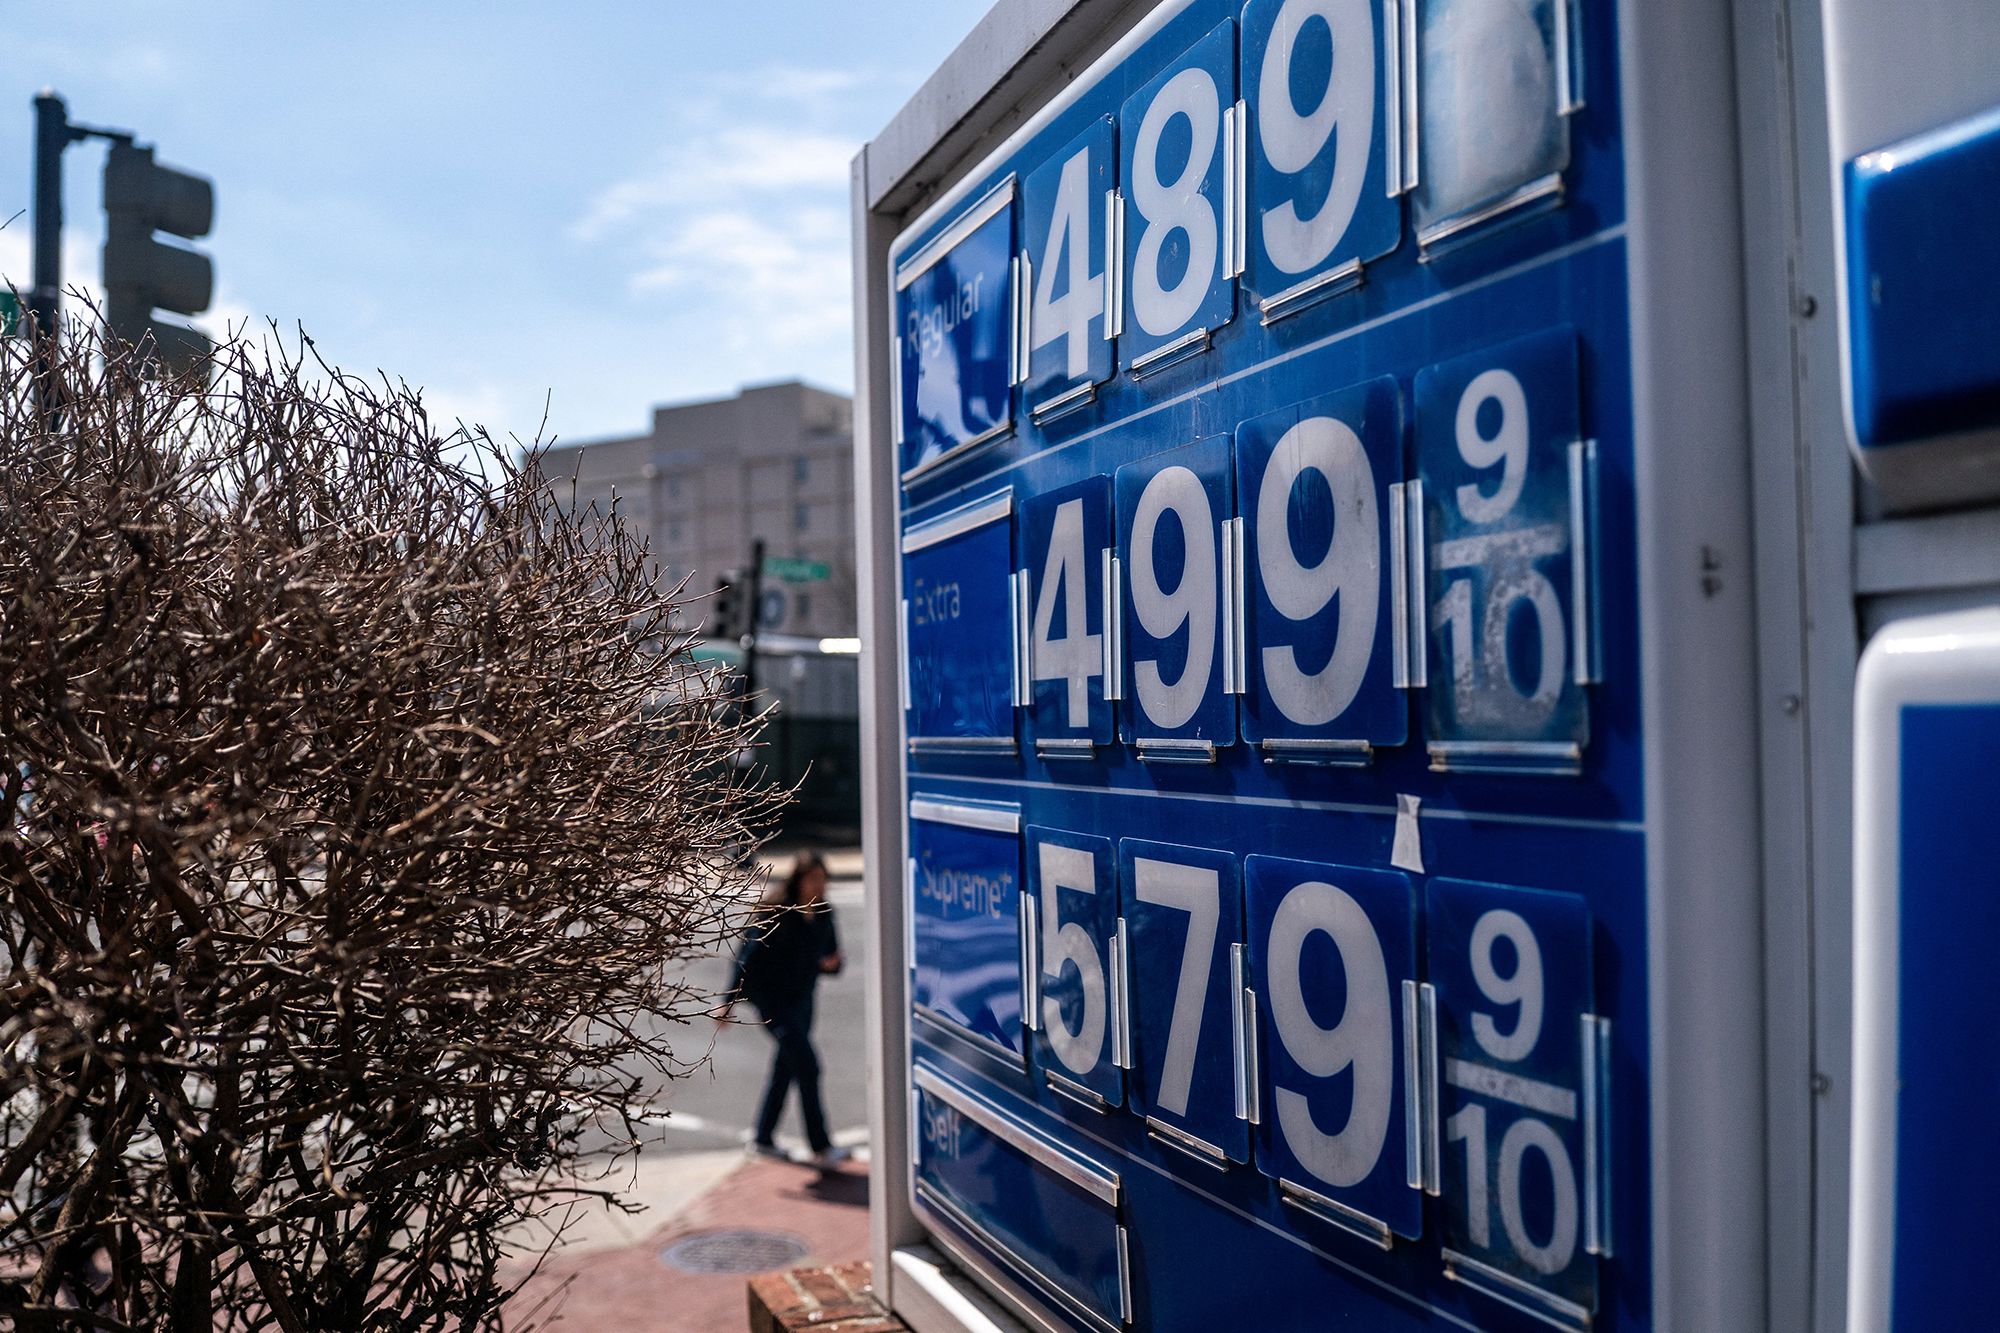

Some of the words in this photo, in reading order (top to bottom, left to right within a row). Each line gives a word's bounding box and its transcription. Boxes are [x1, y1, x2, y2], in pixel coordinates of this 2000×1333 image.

[907, 271, 984, 361] Regular
[914, 577, 961, 626] Extra
[924, 1098, 961, 1161] Self
